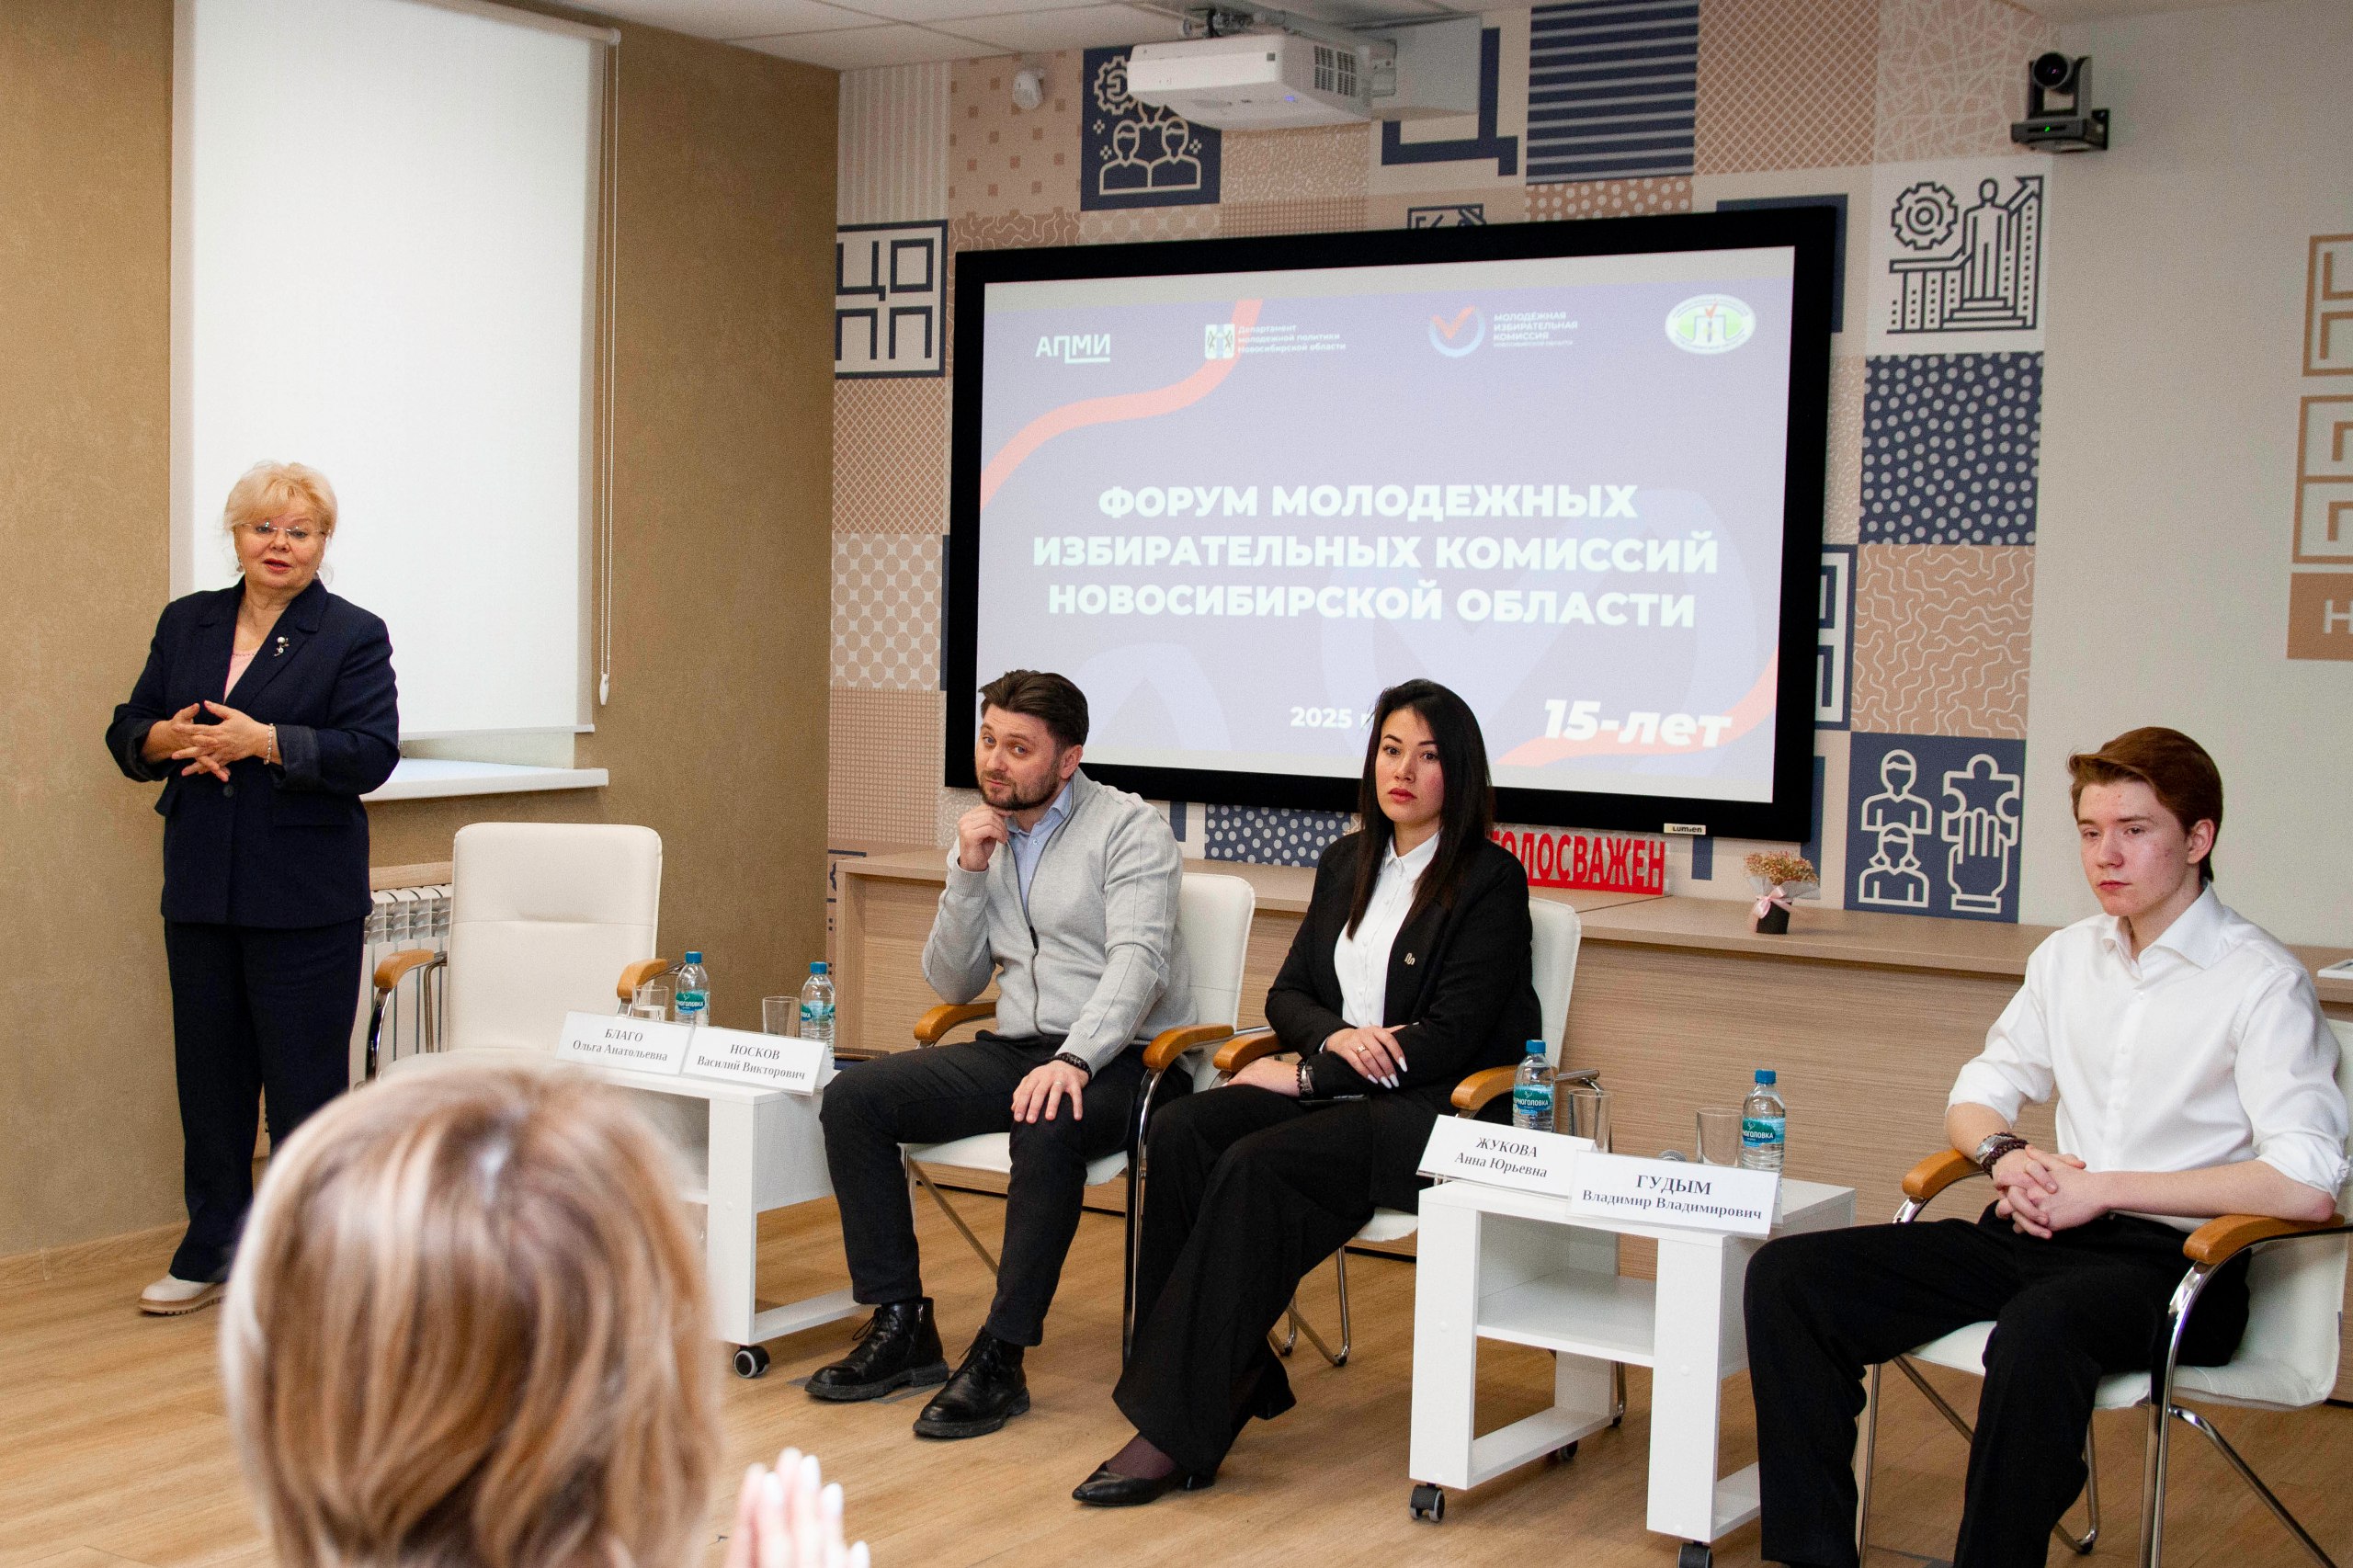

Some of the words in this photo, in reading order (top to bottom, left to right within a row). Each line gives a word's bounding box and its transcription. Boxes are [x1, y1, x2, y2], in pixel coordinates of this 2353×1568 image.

[1493, 331, 1550, 341] КОМИССИЯ
[1494, 321, 1578, 332] ИЗБИРАТЕЛЬНАЯ
[1035, 334, 1111, 364] АПМИ
[1098, 485, 1258, 518] ФОРУМ
[1272, 484, 1639, 522] МОЛОДЕЖНЫХ
[1033, 535, 1422, 568] ИЗБИРАТЕЛЬНЫХ
[1436, 530, 1719, 574] КОМИССИЙ
[1049, 579, 1443, 619] НОВОСИБИРСКОЙ
[1456, 588, 1696, 628] ОБЛАСТИ
[1290, 706, 1353, 729] 2025
[1544, 699, 1733, 748] 15-лет
[605, 1028, 643, 1042] БЛАГО
[573, 1040, 602, 1053] Ольга
[603, 1043, 668, 1062] Анатольевна
[730, 1043, 780, 1061] НОСКОВ
[697, 1055, 741, 1071] Василий
[742, 1062, 806, 1080] Викторович
[1475, 1137, 1538, 1158] ЖУКОВА
[1454, 1152, 1487, 1167] Анна
[1489, 1157, 1548, 1177] Юрьевна
[1636, 1174, 1712, 1195] ГУДЫМ
[1582, 1189, 1652, 1210] Владимир
[1656, 1197, 1762, 1220] Владимирович
